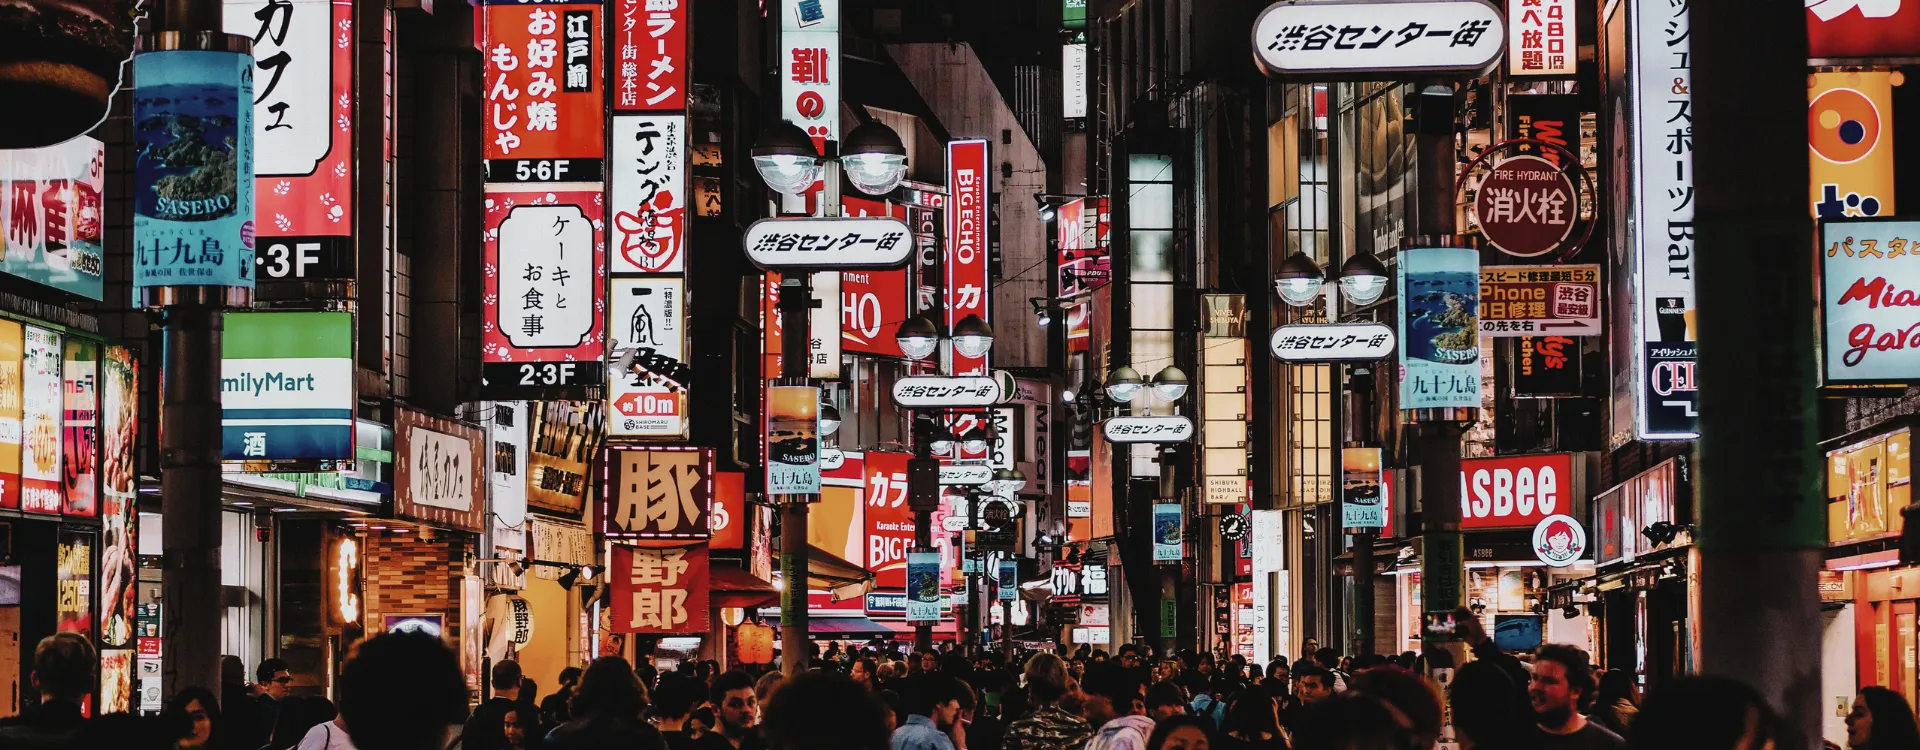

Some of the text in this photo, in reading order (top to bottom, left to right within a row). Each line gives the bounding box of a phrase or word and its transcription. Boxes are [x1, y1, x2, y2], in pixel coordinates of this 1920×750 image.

[622, 0, 638, 60] ンター街
[1268, 20, 1492, 51] 渋谷センター街
[566, 15, 589, 88] 江戸前
[254, 0, 294, 131] カフェ
[527, 8, 558, 131] お好み焼
[490, 43, 521, 155] もんじゃ
[1494, 170, 1559, 183] FIRE HYDRANT
[155, 193, 231, 216] SASEBO
[957, 169, 975, 264] BIG ECHO
[1486, 188, 1567, 225] 消火栓
[137, 237, 225, 267] 九十九島
[753, 231, 904, 251] 渋谷センター街
[1667, 219, 1695, 280] Bar
[552, 216, 571, 309] ケーキと
[521, 263, 544, 337] お食事
[1558, 287, 1589, 303] 渋谷
[1837, 277, 1920, 310] Mia
[1659, 306, 1685, 315] GUINNESS
[1480, 320, 1535, 332] の先を右
[1277, 333, 1388, 349] 渋谷センター街
[1434, 345, 1479, 363] SASEBO
[899, 385, 992, 398] 渋谷センター街
[1413, 374, 1477, 395] 九十九島
[1108, 423, 1187, 436] 渋谷センター街
[243, 432, 267, 457] 酒
[781, 453, 816, 463] SASEBO
[615, 451, 701, 532] 豚
[770, 471, 813, 487] 九十九島
[876, 520, 900, 531] Karaoke
[985, 509, 1009, 521] 消火栓
[1345, 510, 1378, 521] 九十九島
[869, 534, 901, 569] BIG
[1473, 549, 1493, 558] ASBee
[630, 548, 690, 630] 野郎
[1080, 565, 1107, 596] 福
[513, 599, 530, 644] 豚野郎
[909, 607, 939, 618] 九十九島
[1256, 605, 1266, 634] BAR
